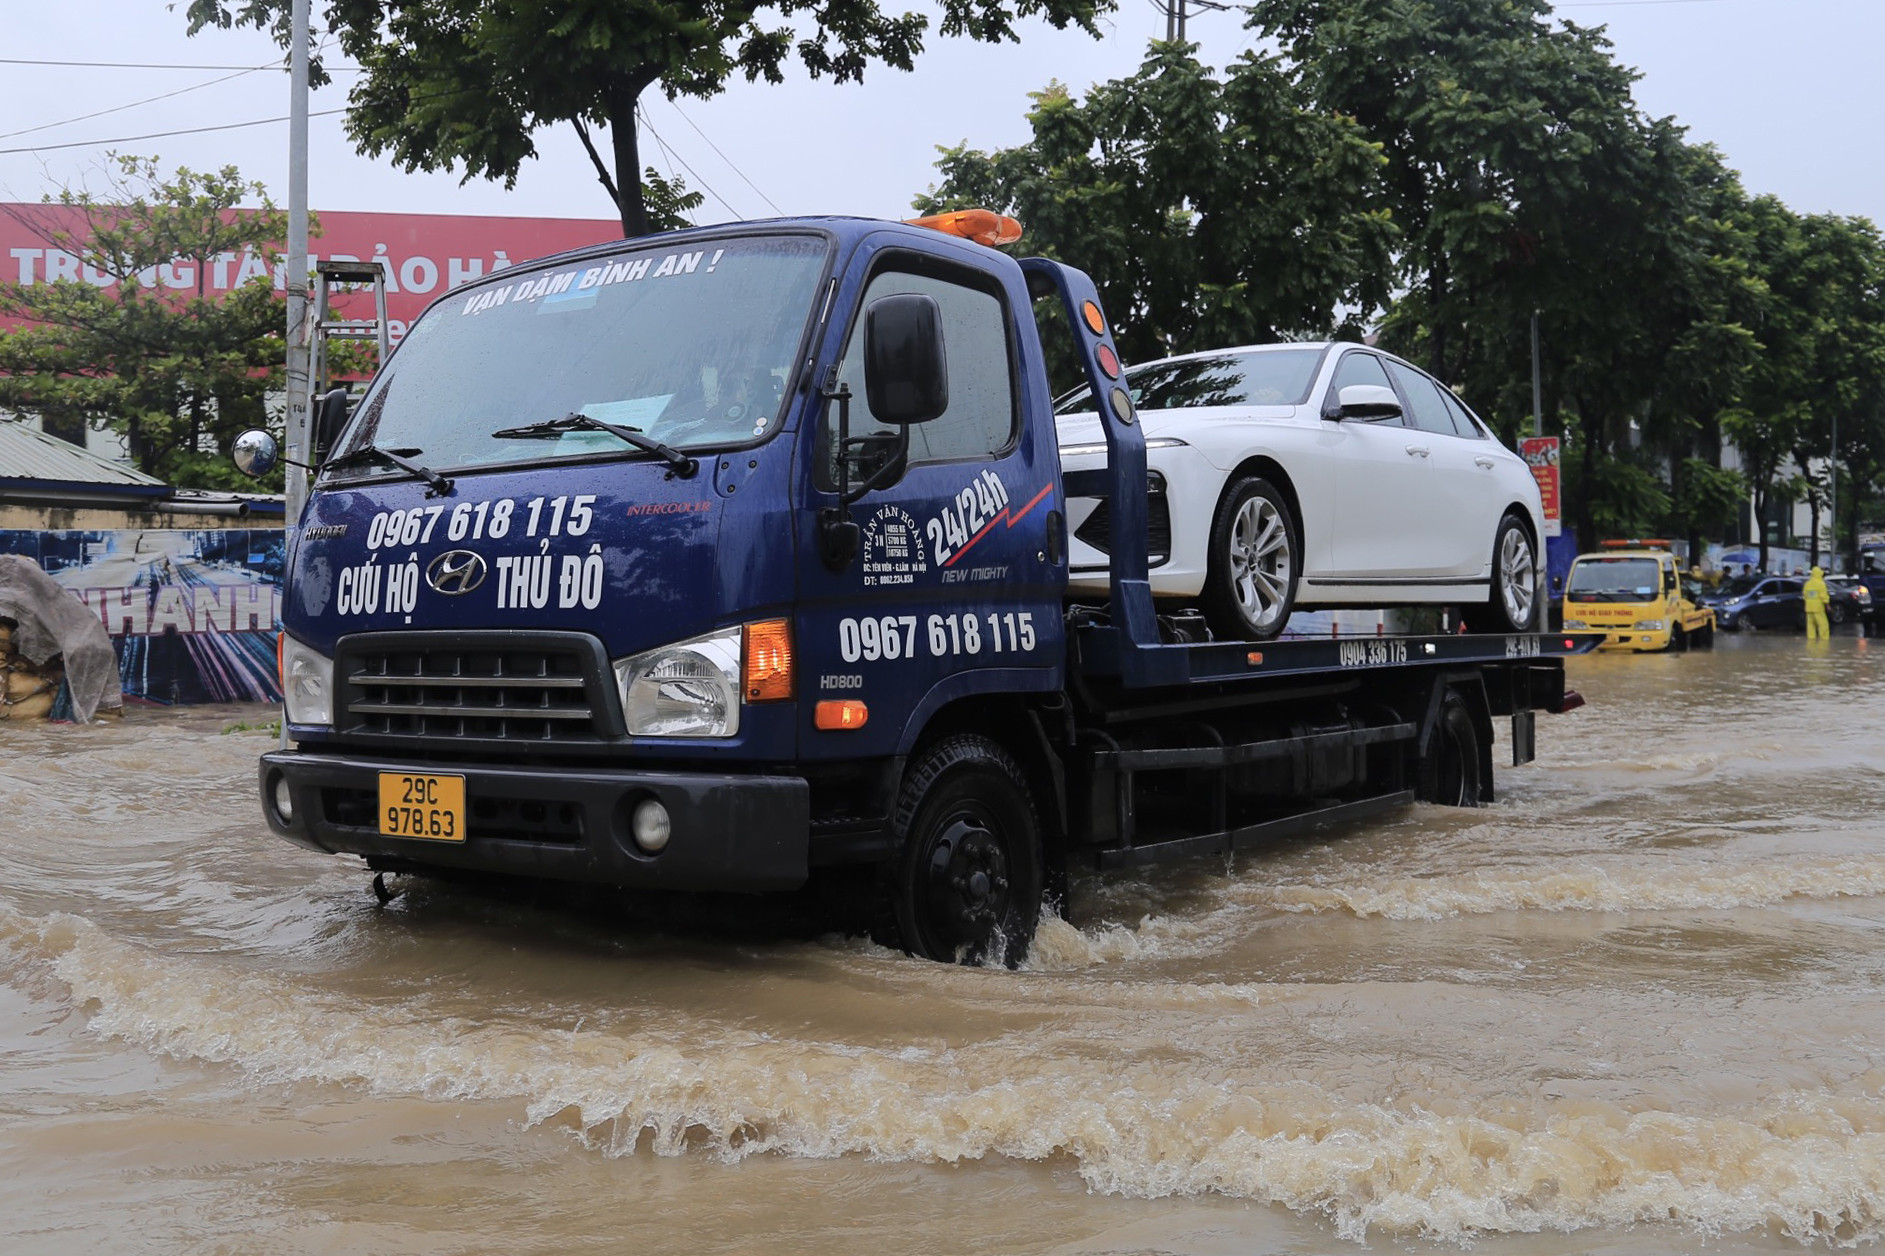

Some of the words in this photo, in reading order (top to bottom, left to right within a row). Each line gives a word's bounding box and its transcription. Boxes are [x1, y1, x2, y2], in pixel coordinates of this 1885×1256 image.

[462, 285, 513, 316] VẠN
[512, 272, 576, 303] DẶM
[578, 259, 652, 290] BÌNH
[653, 251, 704, 278] AN
[367, 505, 445, 550] 0967
[447, 498, 515, 542] 618
[526, 495, 597, 537] 115
[626, 500, 712, 517] INTERCOOLER
[926, 469, 1009, 567] 24/24h
[337, 553, 382, 616] CỨU
[385, 552, 419, 624] HỘ
[496, 537, 552, 610] THỦ
[558, 543, 604, 610] ĐÔ
[942, 568, 968, 583] NEW
[971, 566, 1008, 581] MIGHTY
[839, 615, 917, 663] 0967
[927, 613, 981, 657] 618
[988, 612, 1036, 653] 115
[1340, 641, 1366, 667] 0904
[1368, 641, 1387, 665] 336
[1389, 640, 1407, 662] 175
[820, 675, 863, 689] HD800
[402, 777, 438, 805] 29C
[388, 806, 454, 837] 978.63
